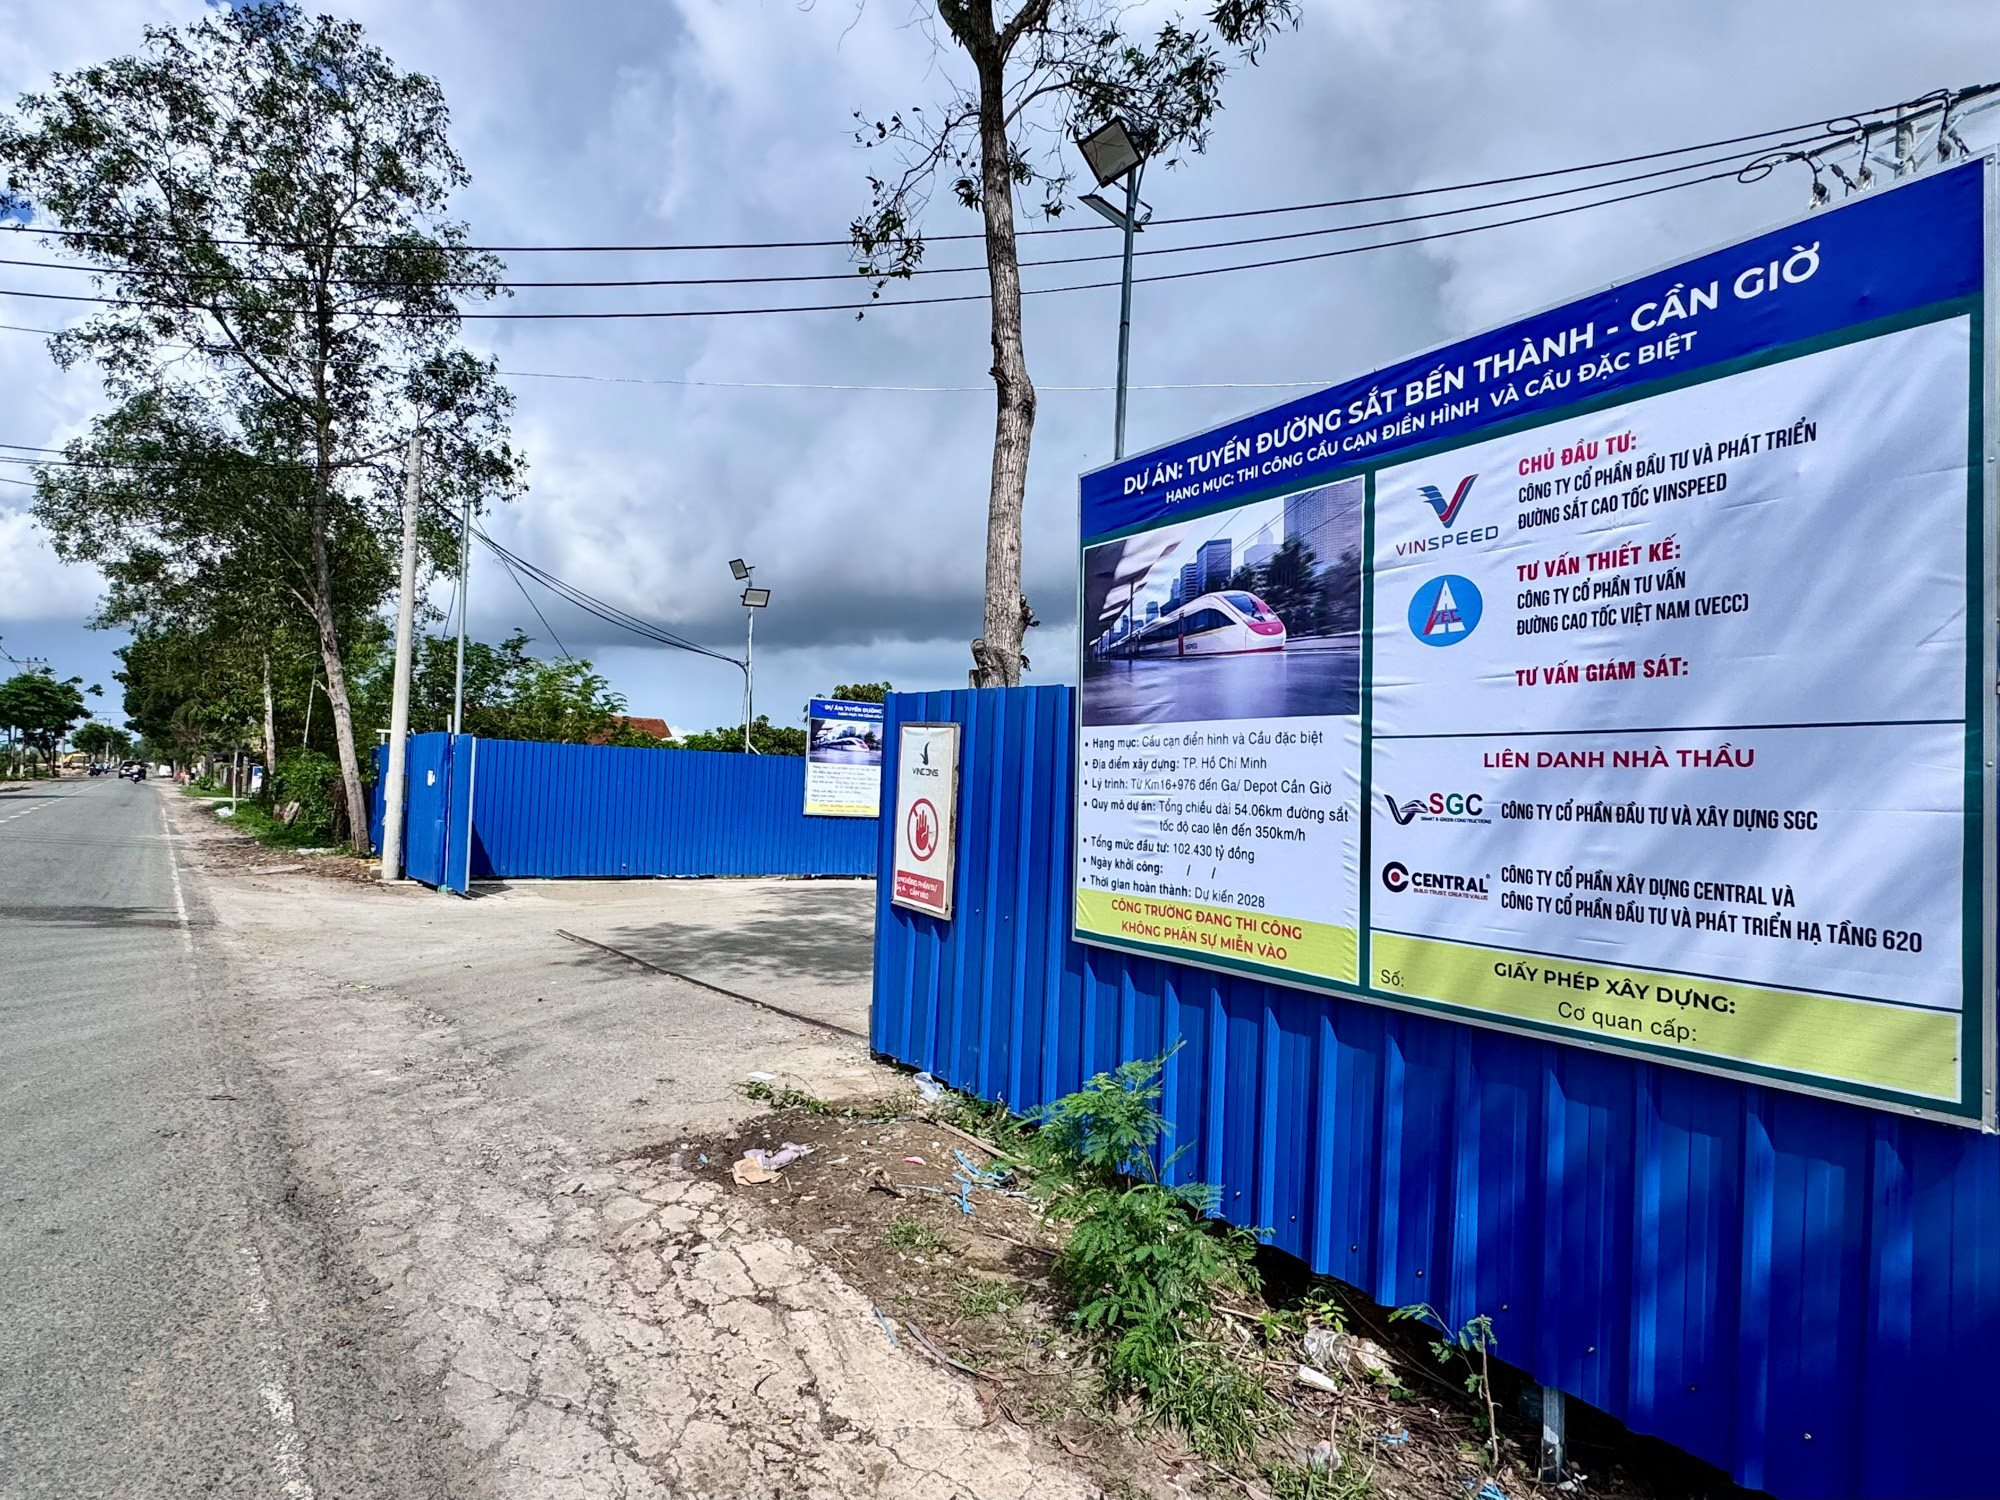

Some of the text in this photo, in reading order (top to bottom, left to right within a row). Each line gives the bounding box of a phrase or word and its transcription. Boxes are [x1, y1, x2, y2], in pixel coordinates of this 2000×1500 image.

[1124, 468, 1149, 496] DỰ
[1152, 461, 1183, 486] ÁN:
[1187, 435, 1250, 475] TUYẾN
[1256, 409, 1341, 454] ĐƯỜNG
[1348, 386, 1397, 424] SẮT
[1405, 364, 1464, 406] BẾN
[1473, 322, 1594, 383] THÀNH
[1630, 282, 1718, 332] CẦN
[1733, 241, 1820, 299] GIỜ
[1166, 331, 1697, 503] HẠNG MỤC: THI CÔNG CẦU CẠN ĐIỂN HÌNH VÀ CẦU ĐẶC BIỆT
[1519, 430, 1636, 476] CHỦ ĐẦU TƯ:
[1519, 416, 1816, 503] CÔNG TY CỔ PHẦN ĐẦU TƯ VÀ PHÁT TRIỂN
[1518, 472, 1727, 530] ĐƯỜNG SẮT CAO TỐC VINSPEED
[1396, 525, 1498, 556] VINSPEED
[1516, 533, 1681, 582] TƯ VẤN THIẾT KẾ:
[1517, 566, 1686, 609] CÔNG TY CỔ PHẦN TƯ VẤN
[1517, 593, 1749, 636] ĐƯỜNG CAO TỐC VIỆT NAM (VECC)
[1516, 653, 1689, 687] TƯ VẤN GIÁM SÁT:
[1092, 730, 1323, 751] Hạng đặc biệt
[1483, 742, 1754, 768] LIÊN DANH NHÀ THẦU
[1108, 756, 1267, 772] điểm xây Minh
[1144, 777, 1332, 795] Km16+976 đến Depot Giờ
[1091, 798, 1349, 824] Quy Tổng 54.06km đường sắt
[1429, 792, 1483, 816] SGC
[1501, 798, 1818, 832] CÔNG TY CỔ PHẦN ĐẦU TƯ VÀ XÂY DỰNG SGC
[1159, 818, 1306, 841] tốc độ cao lên đến 350km/h
[1090, 855, 1112, 870] Ngày
[1173, 843, 1224, 861] 102.430 tỷ
[1195, 887, 1265, 908] Dự kiến 2028
[1412, 872, 1488, 893] CENTRAL
[1501, 864, 1795, 908] CÔNG TY CỔ PHẦN XÂY DỰNG CENTRAL VÀ
[1111, 897, 1302, 940] CÔNG TRƯỜNG ĐANG THI CÔNG
[1501, 891, 1922, 953] CÔNG TY CỔ PHẦN ĐẦU TƯ VÀ PHÁT TRIỂN HẠ TẦNG 620
[1121, 920, 1161, 937] KHÔNG
[1200, 932, 1218, 949] SỰ
[1220, 934, 1253, 956] MIỄN
[1257, 941, 1287, 960] VÀO
[1380, 969, 1405, 988] Số:
[1493, 960, 1736, 1015] GIẤY PHÉP XÂY DỰNG:
[1558, 1001, 1697, 1043] Cơ quan cấp:
